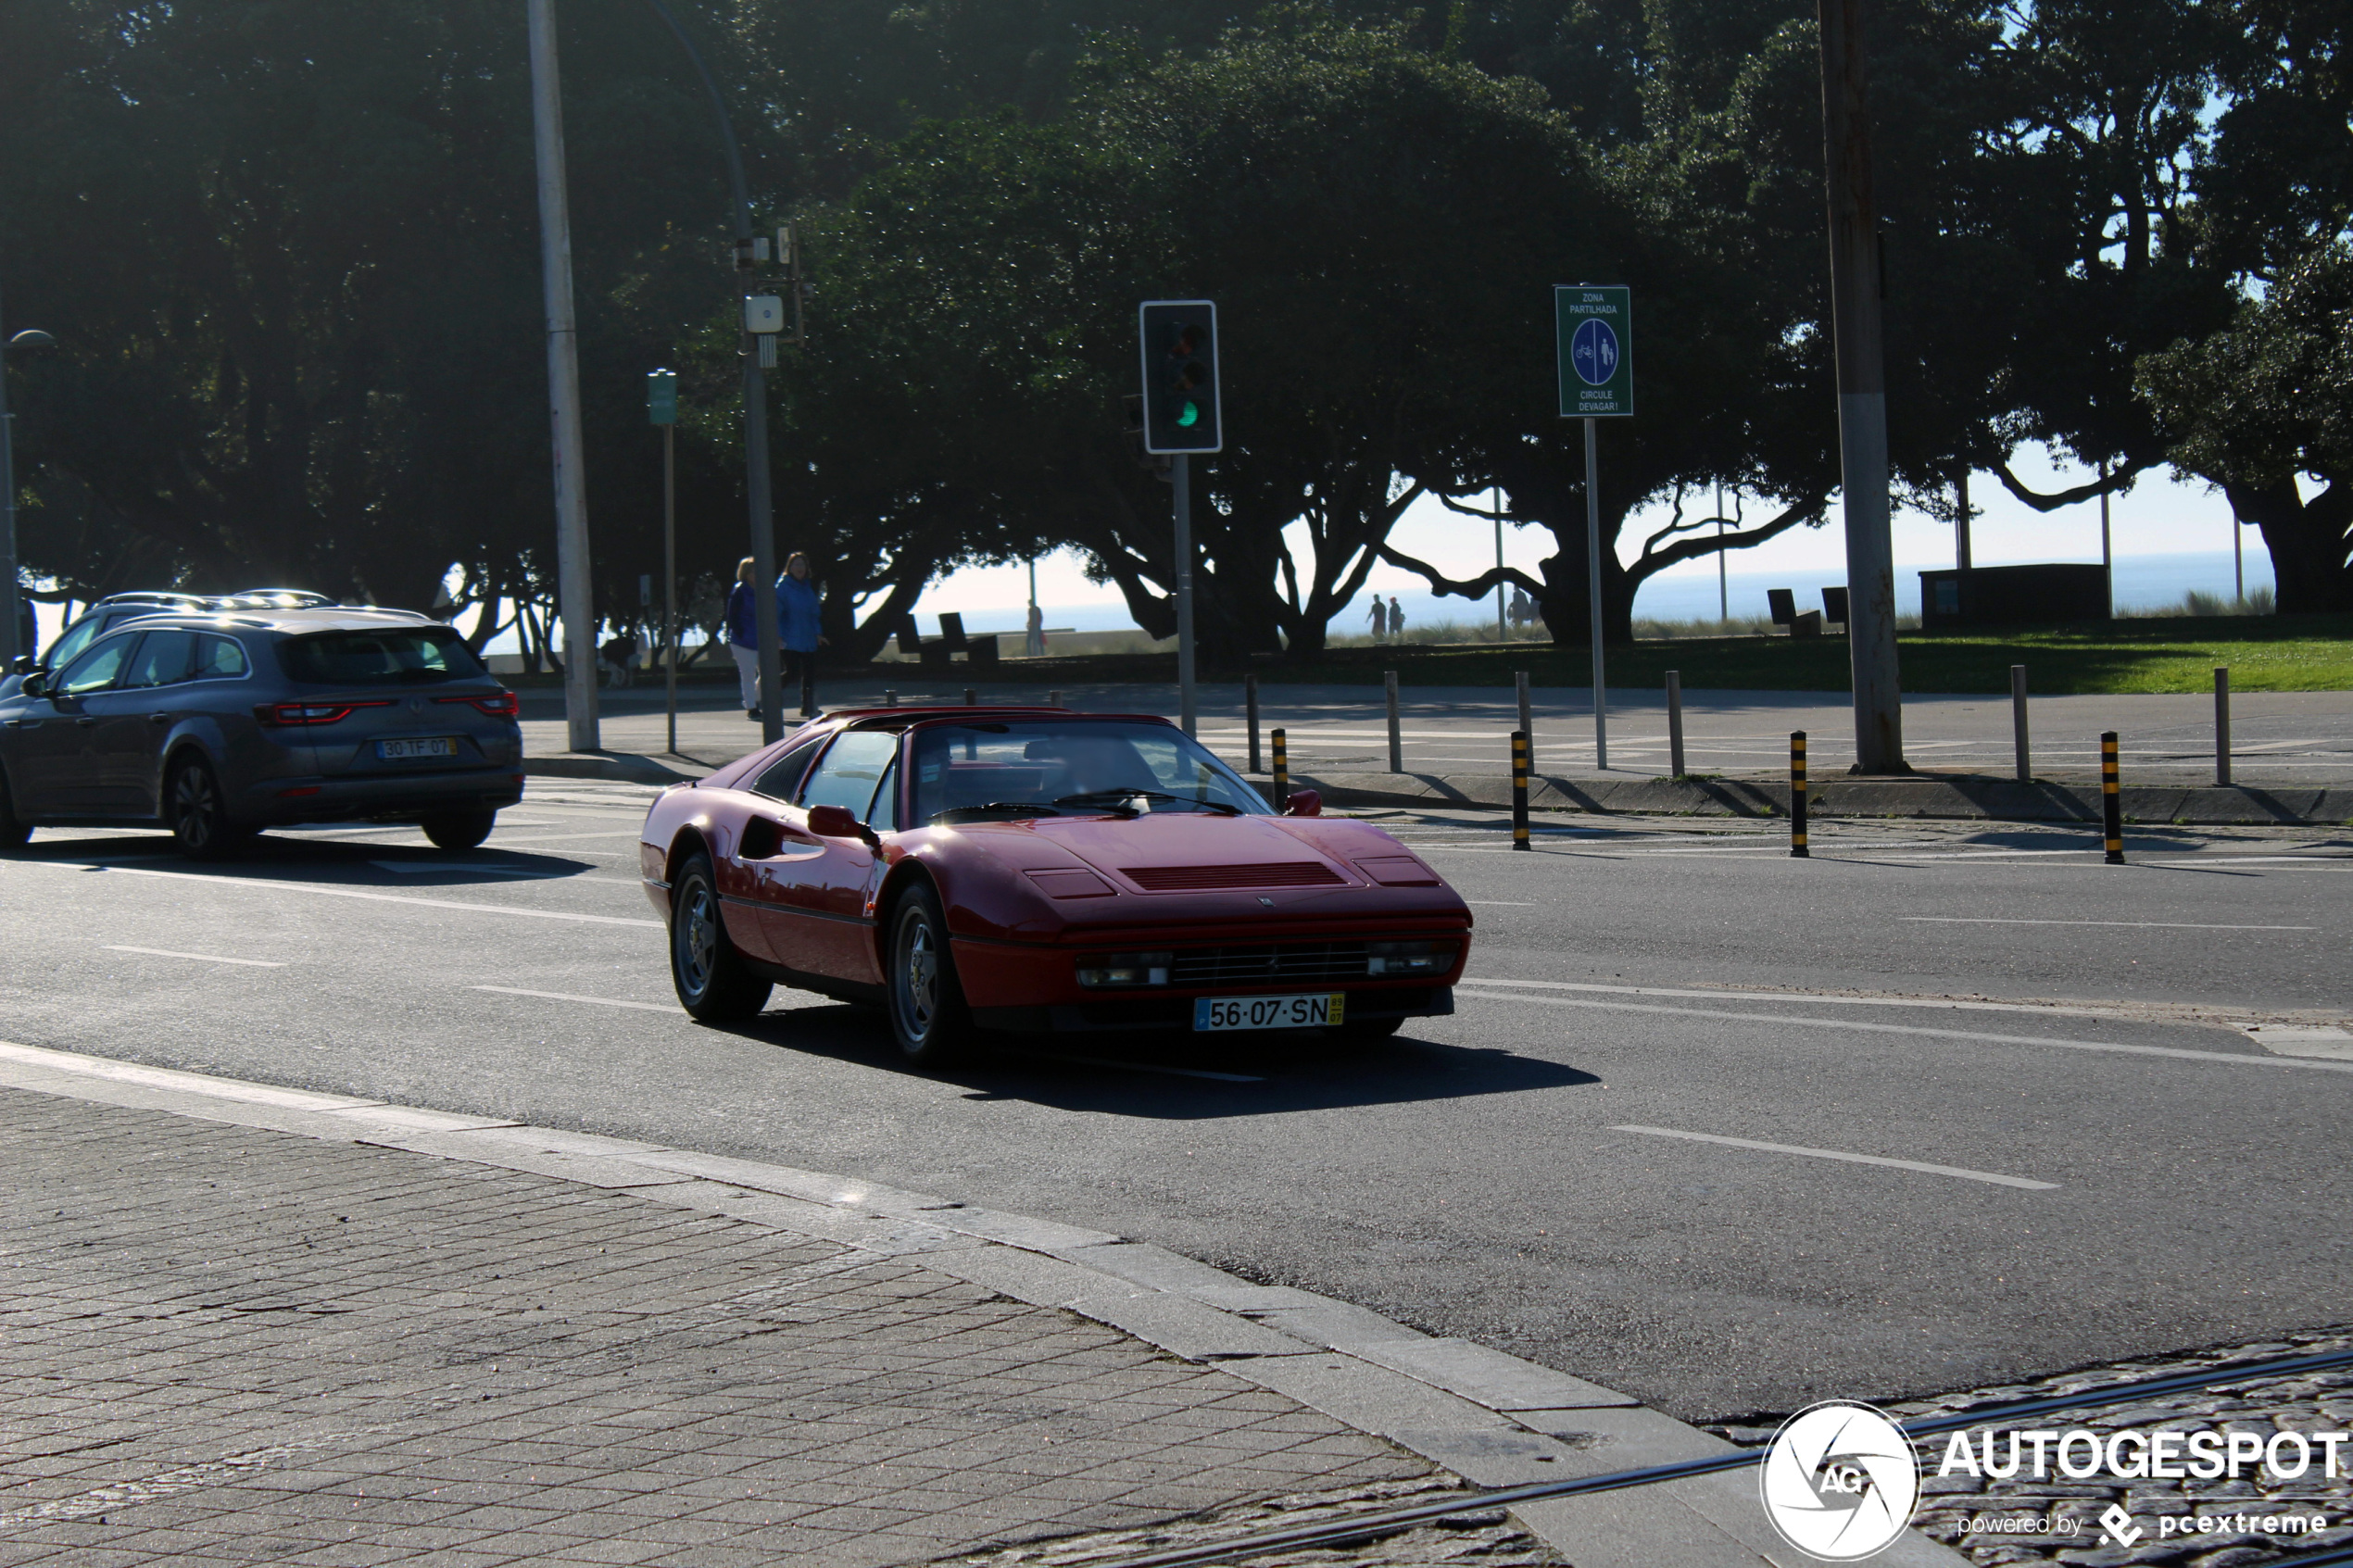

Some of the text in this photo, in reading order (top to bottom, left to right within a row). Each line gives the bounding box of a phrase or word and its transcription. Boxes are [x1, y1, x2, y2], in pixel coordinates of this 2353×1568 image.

[1582, 293, 1604, 303] ZONA
[1569, 305, 1617, 314] PARTILHADA
[1580, 390, 1613, 399] CIRCULE
[1579, 402, 1618, 411] DEVAGAR!
